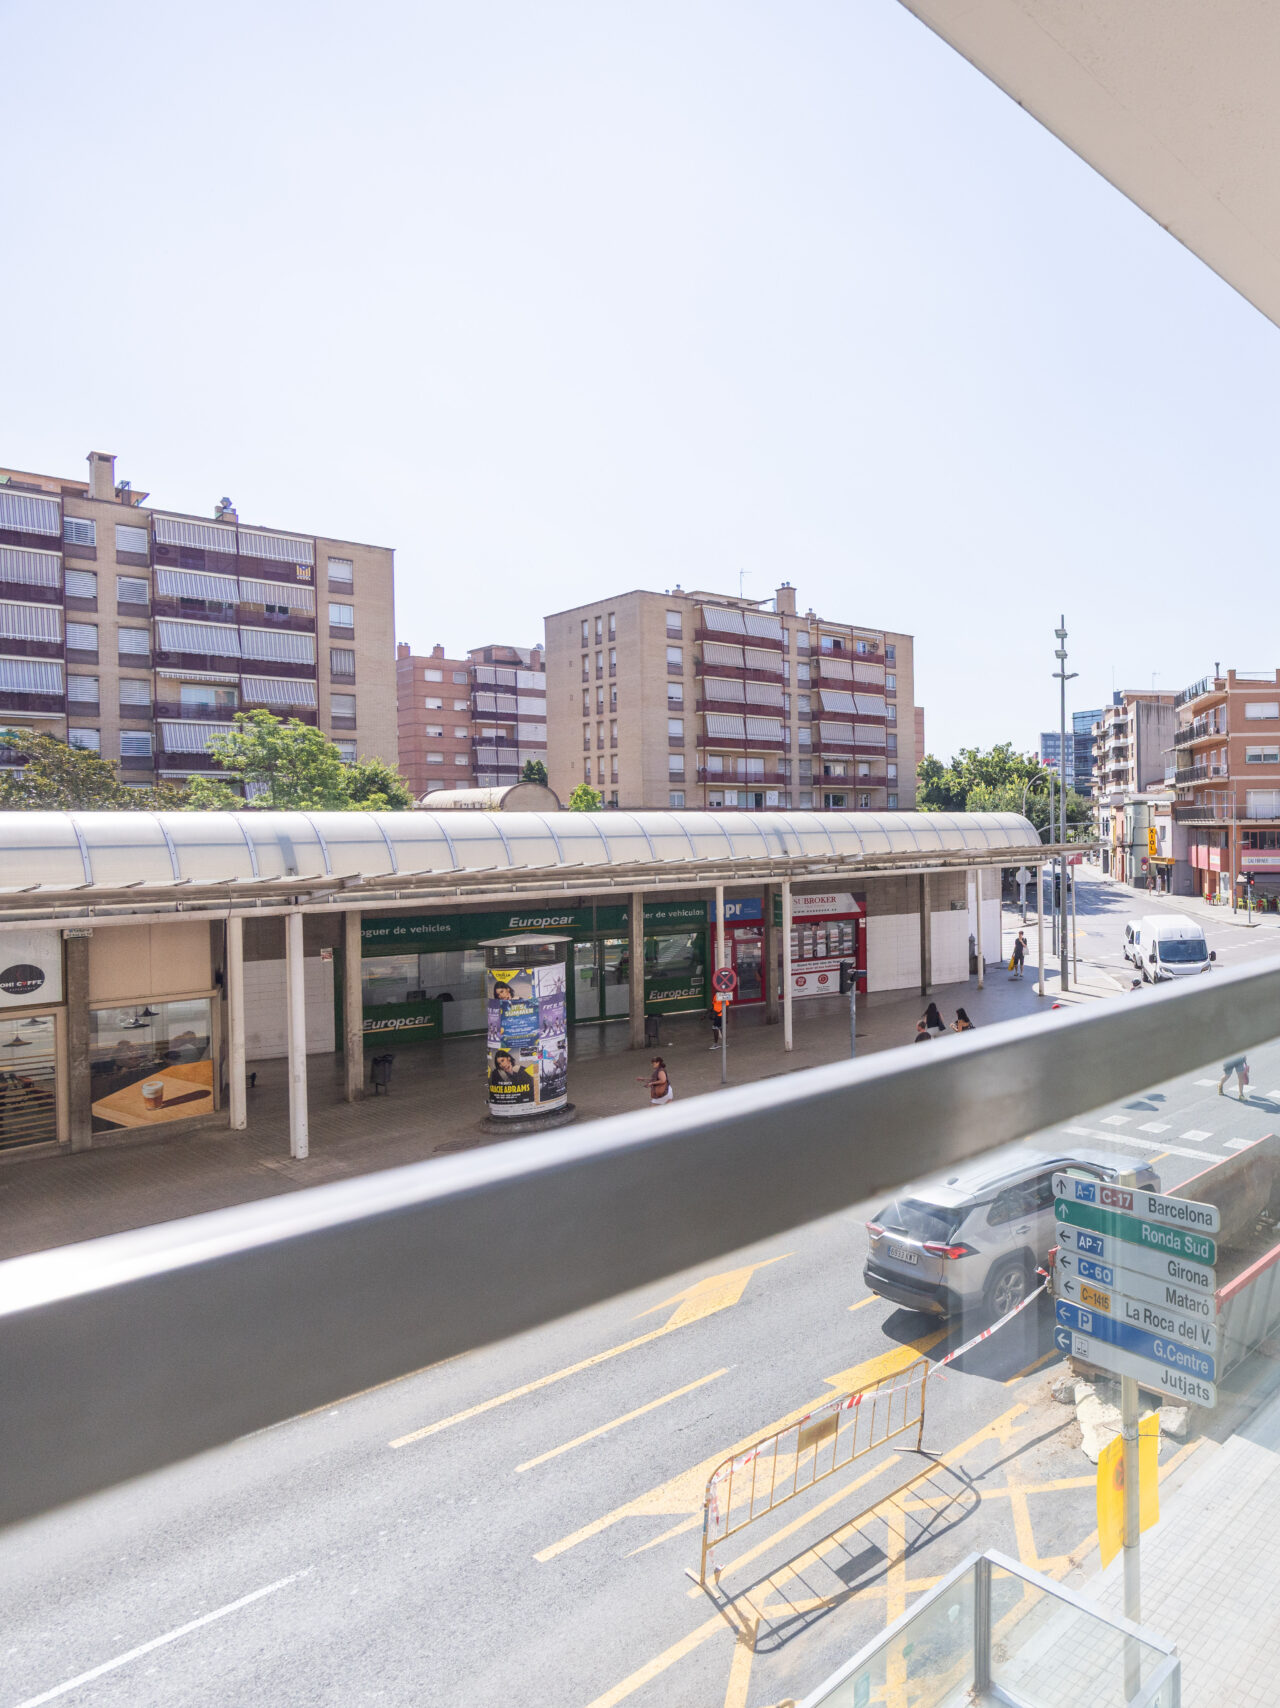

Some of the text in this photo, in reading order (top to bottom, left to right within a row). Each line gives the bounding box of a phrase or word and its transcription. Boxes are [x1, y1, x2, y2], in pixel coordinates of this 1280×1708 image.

[393, 926, 406, 935] de
[410, 924, 451, 934] vehicles
[508, 916, 575, 928] Europcar
[649, 988, 701, 1000] Europcar
[363, 1015, 431, 1030] Europcar
[1076, 1184, 1213, 1226] A-7 C-17 Barcelona
[1142, 1224, 1209, 1258] Ronda Sud
[1079, 1236, 1209, 1287] AP-7 Girona
[1080, 1262, 1210, 1316] C-60 Mataró
[1082, 1288, 1212, 1346] C-1415 La Roca del V.
[1081, 1313, 1209, 1374] P G.Centre
[1161, 1370, 1210, 1400] Jutjats
